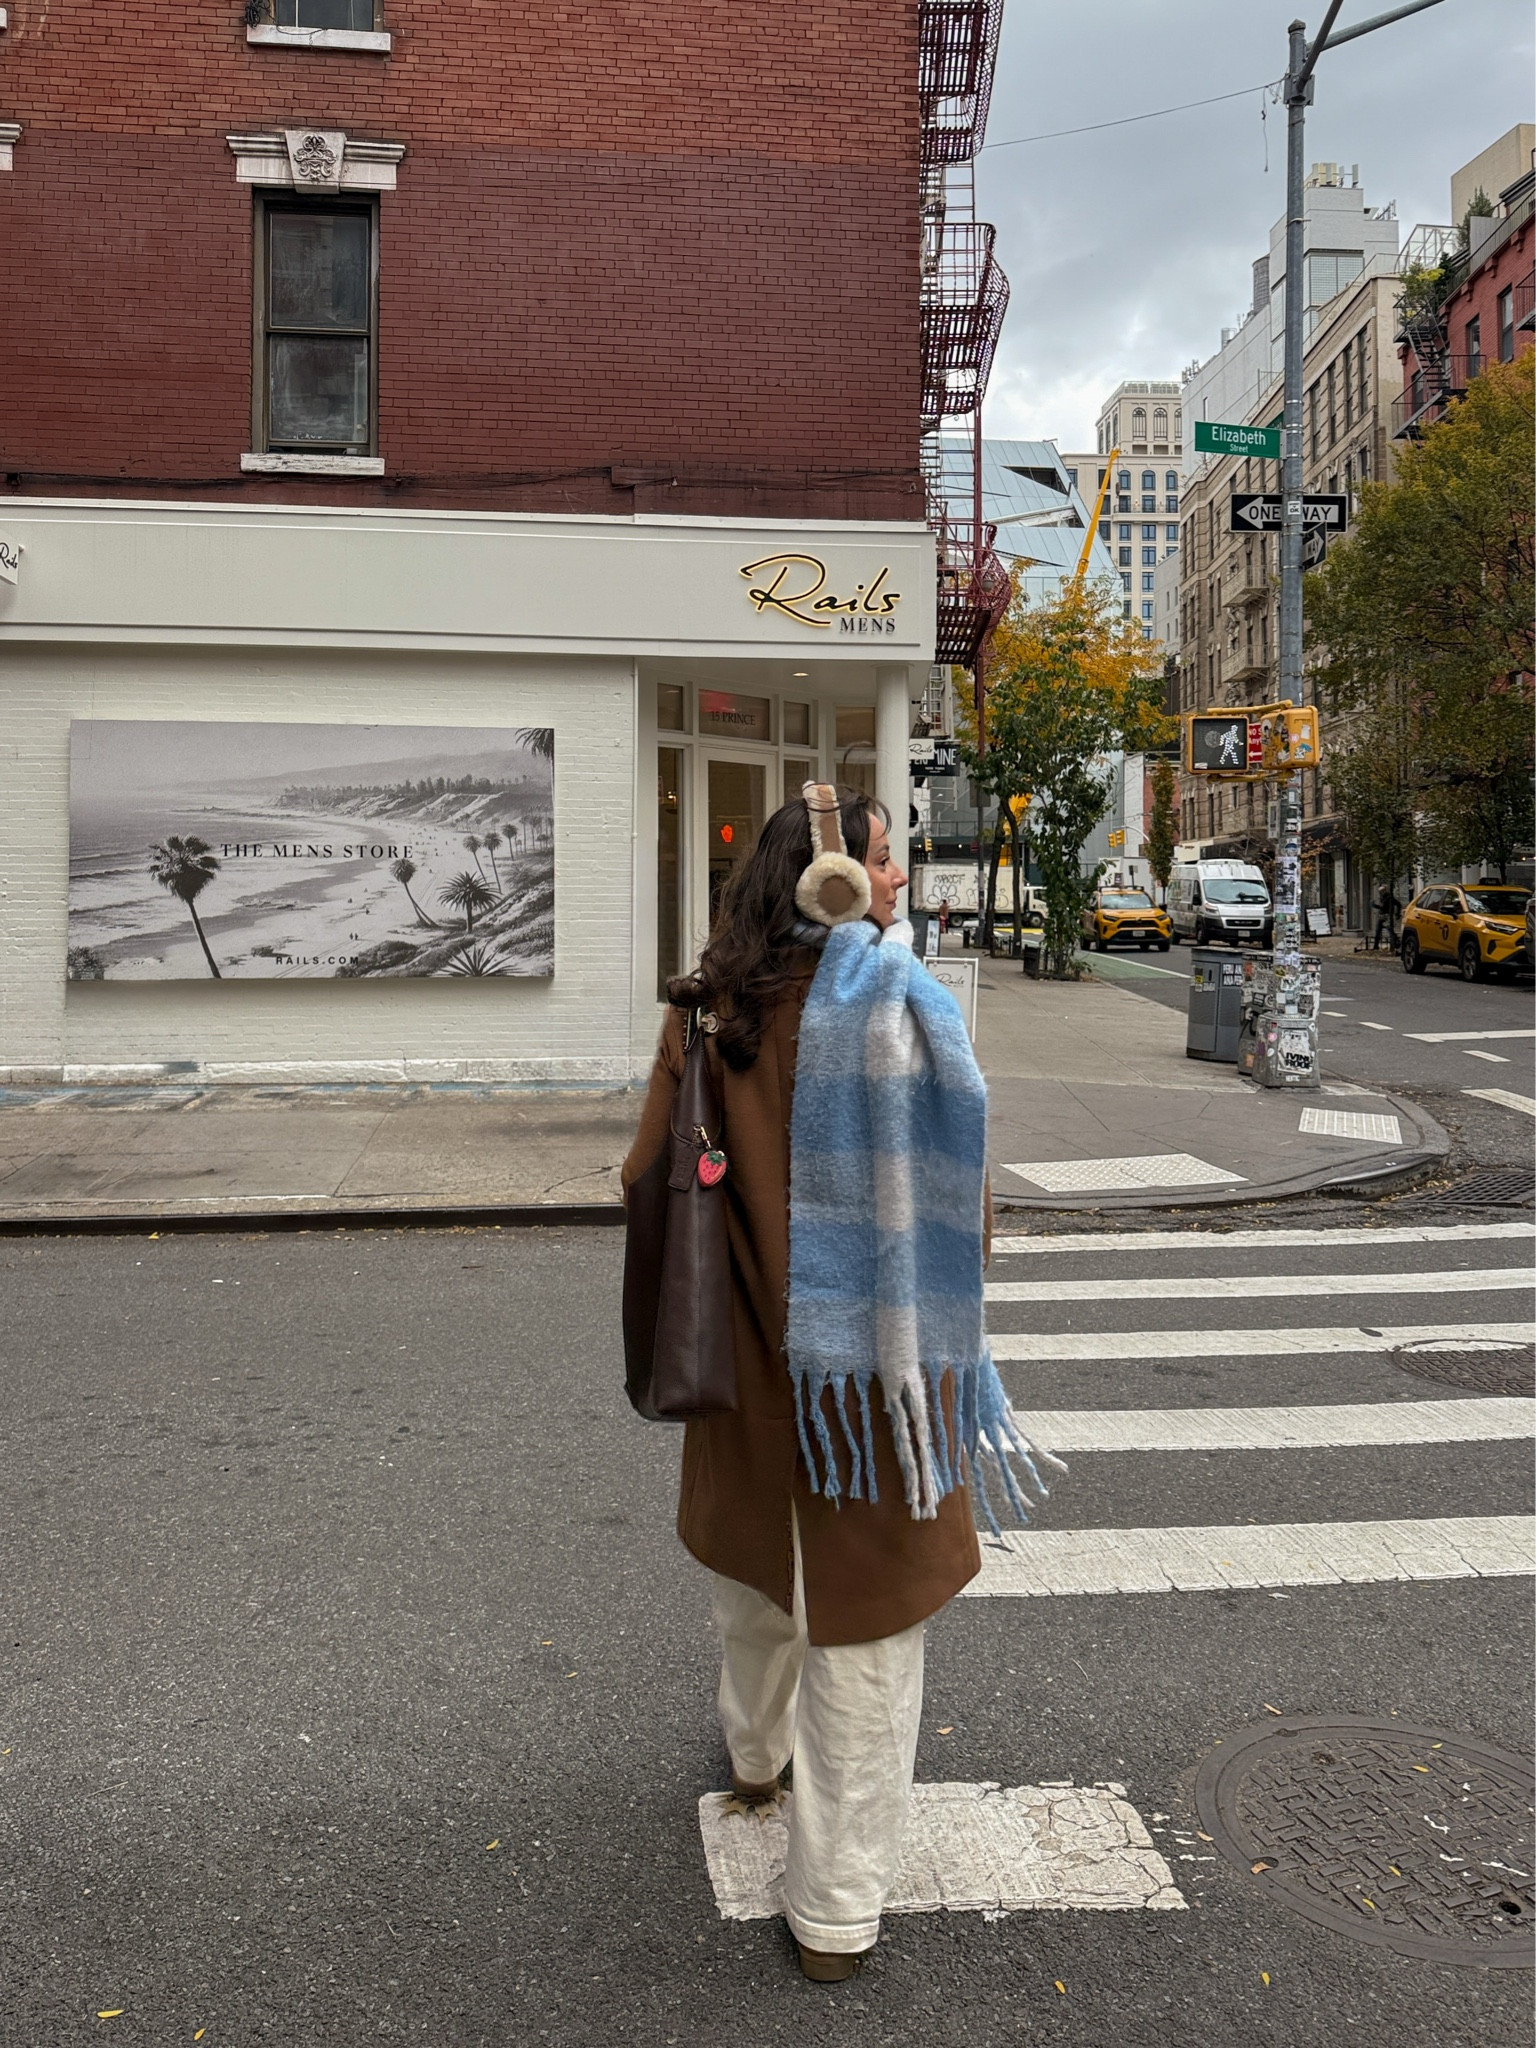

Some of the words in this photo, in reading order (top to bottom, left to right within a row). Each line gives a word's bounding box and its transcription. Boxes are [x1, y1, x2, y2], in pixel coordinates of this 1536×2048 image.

[1212, 426, 1266, 445] Elizabeth
[1230, 443, 1248, 453] Street
[1249, 506, 1281, 520] ONE
[740, 553, 901, 625] Rails
[840, 617, 896, 633] MENS
[722, 712, 756, 725] PRINCE
[909, 743, 933, 755] Rails
[220, 843, 263, 857] THE
[272, 844, 333, 857] MENS
[343, 845, 414, 859] STORE
[275, 956, 359, 965] RAILS.COM
[936, 973, 965, 987] Rails
